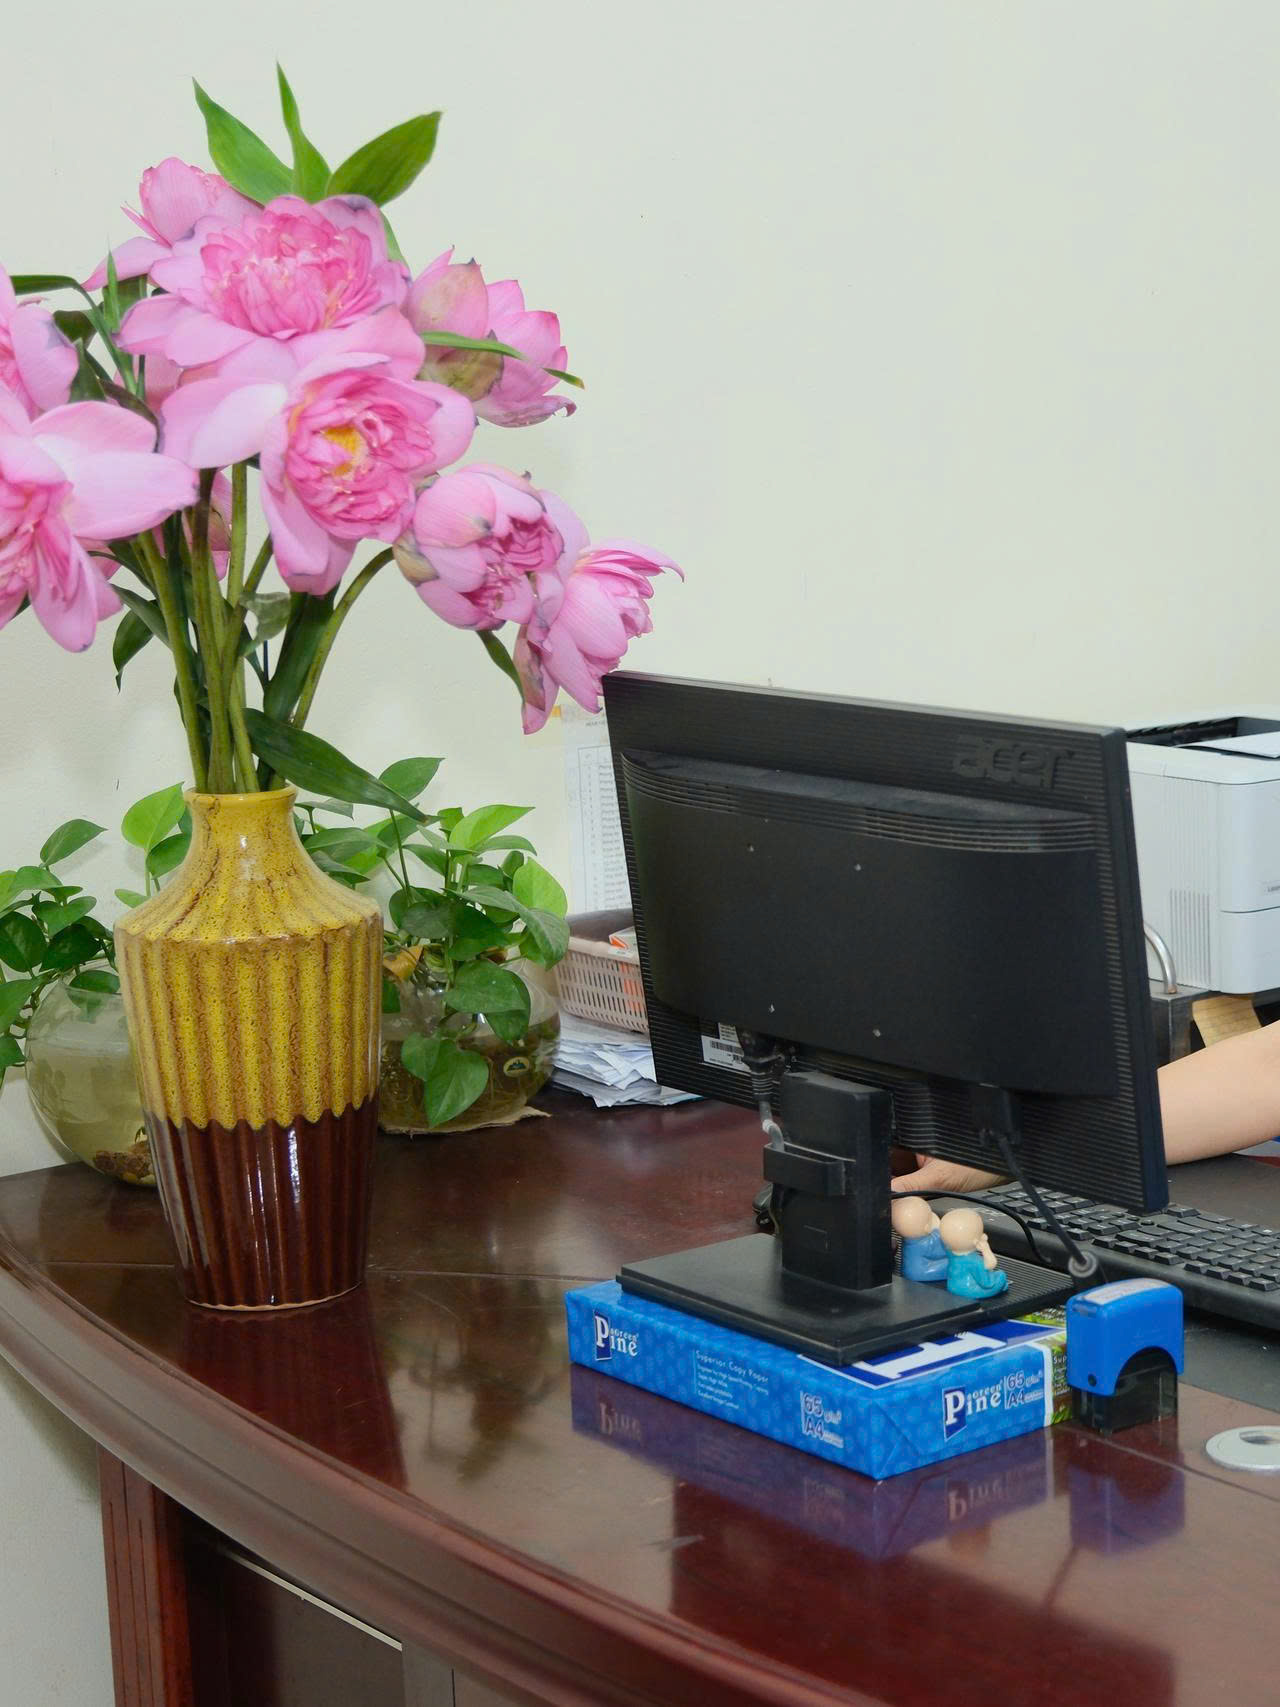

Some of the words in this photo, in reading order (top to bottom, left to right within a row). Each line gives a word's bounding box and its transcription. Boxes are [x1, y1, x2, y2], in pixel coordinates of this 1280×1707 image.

[595, 1315, 638, 1357] Pine
[696, 1350, 726, 1368] Superior
[729, 1361, 746, 1377] Copy
[804, 1392, 824, 1417] 65
[945, 1391, 1001, 1425] Pine
[1007, 1389, 1025, 1410] A4
[806, 1416, 825, 1441] A4
